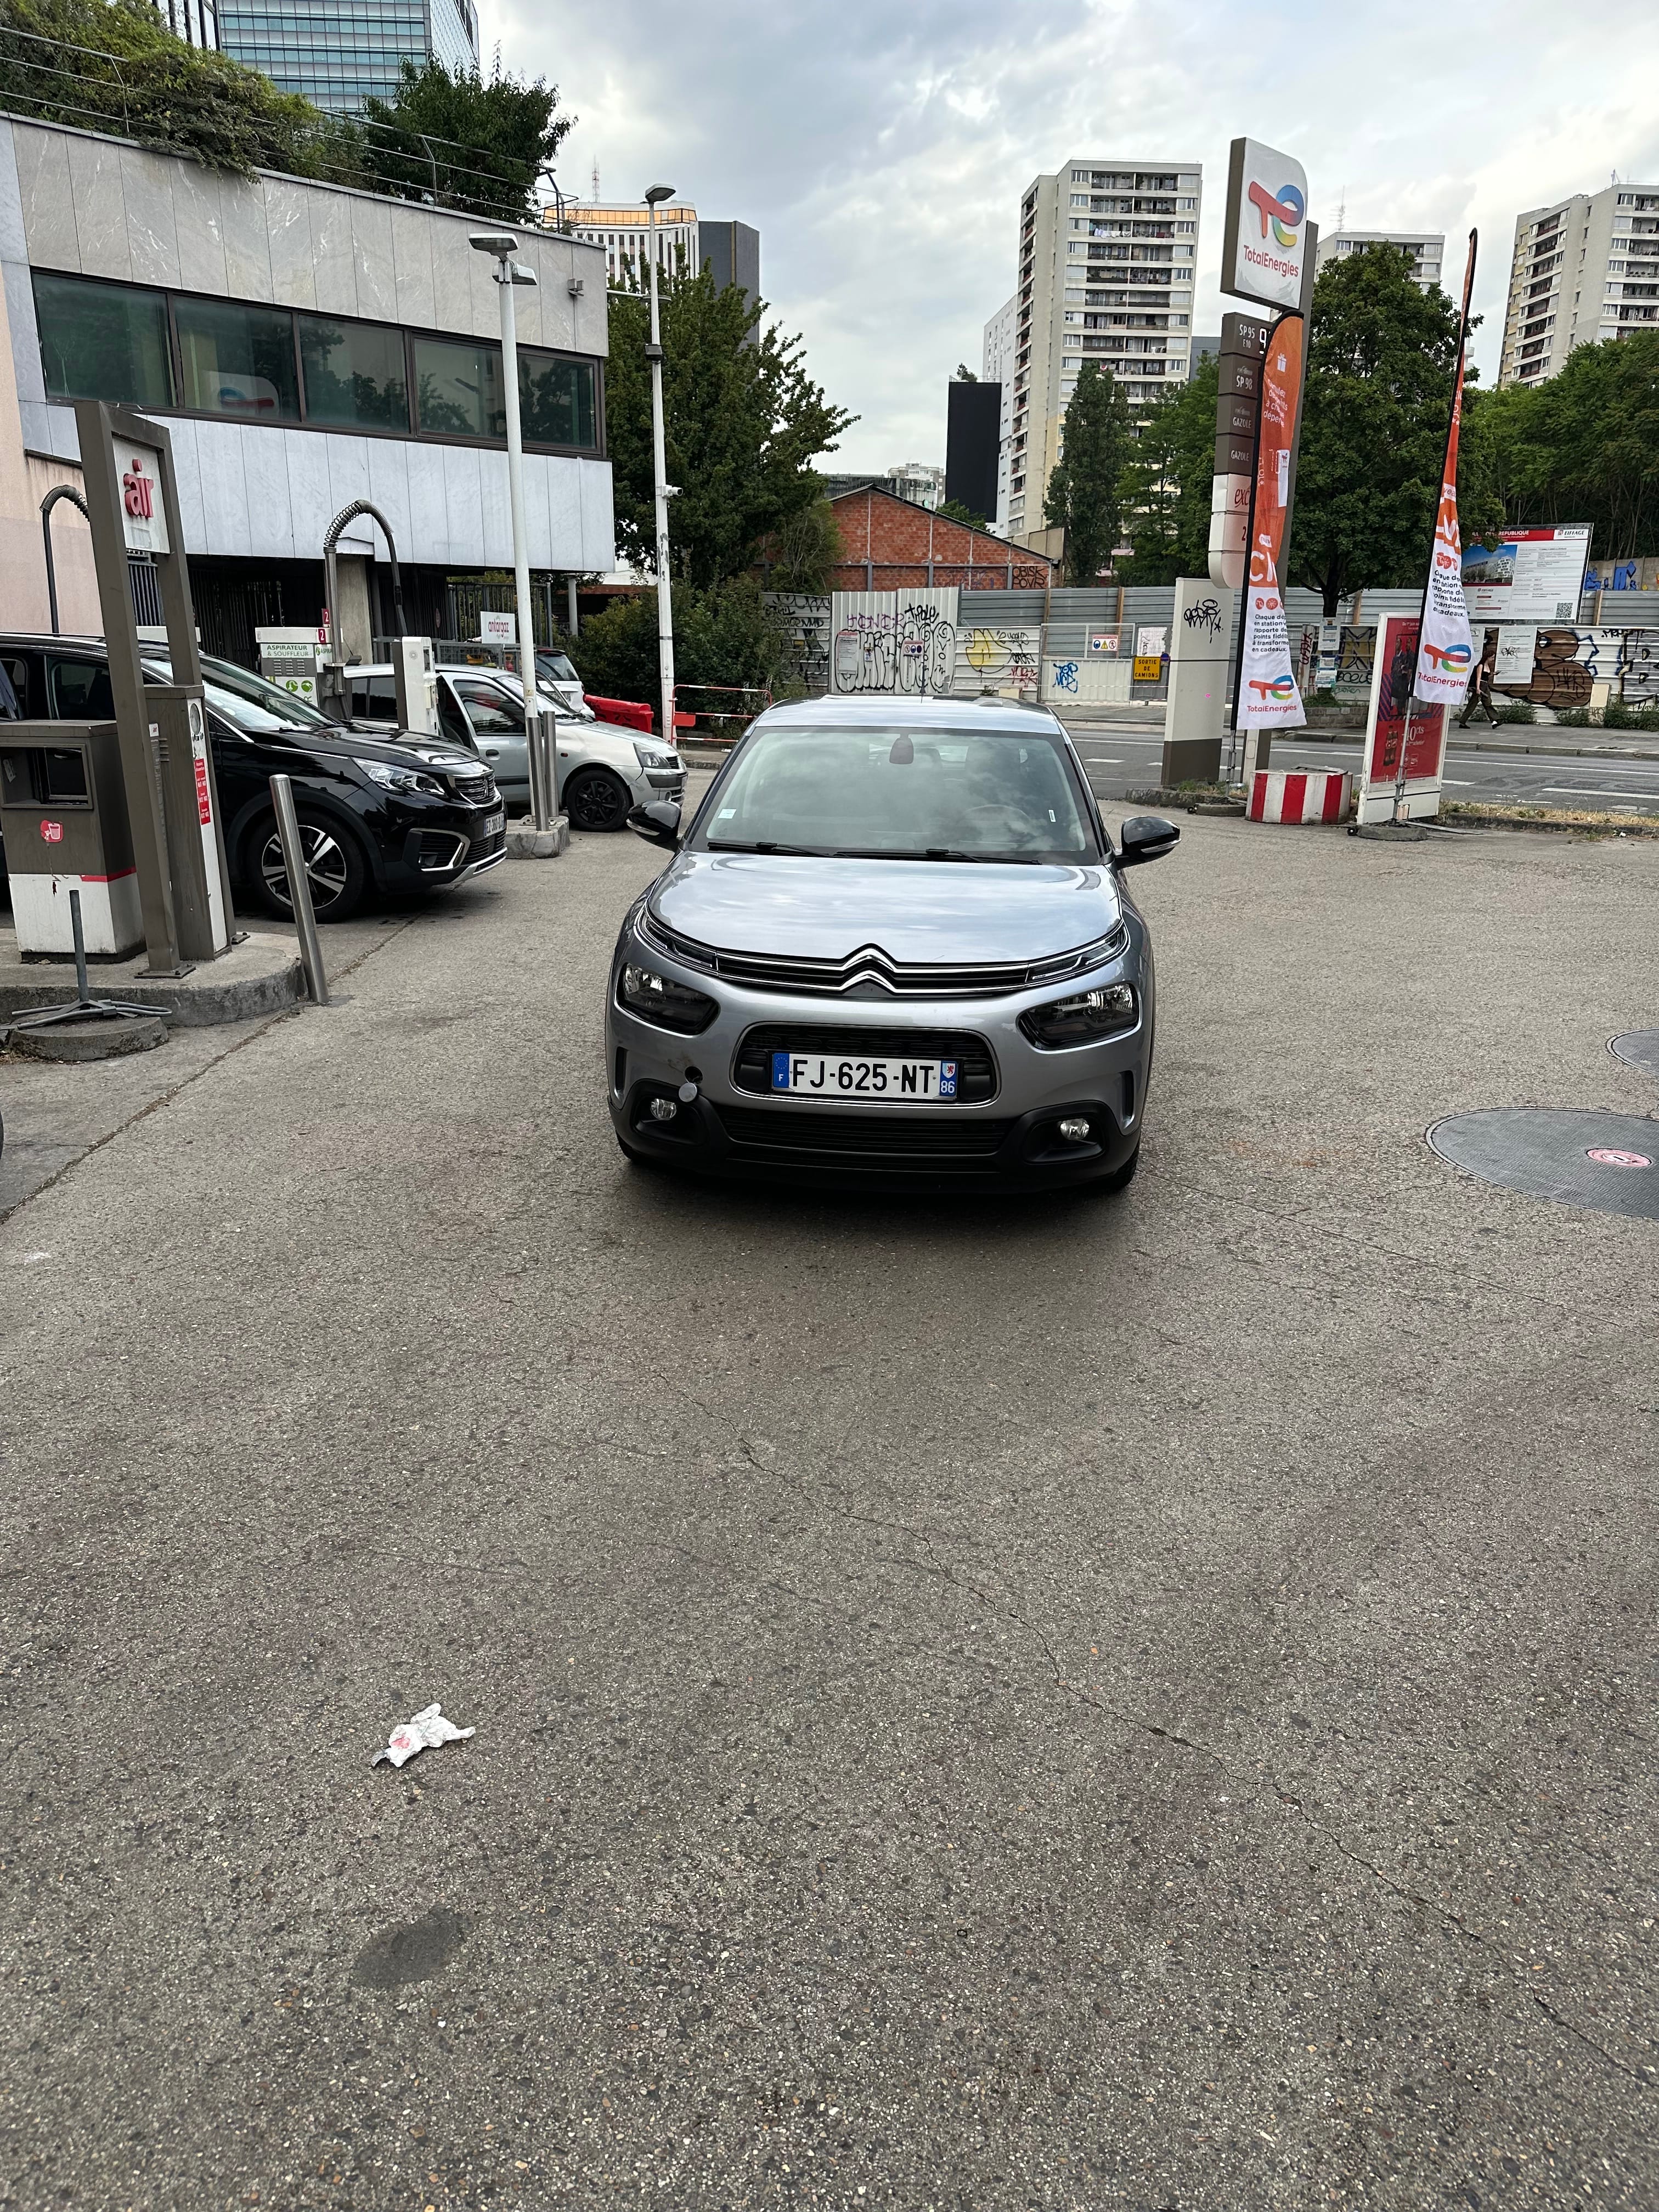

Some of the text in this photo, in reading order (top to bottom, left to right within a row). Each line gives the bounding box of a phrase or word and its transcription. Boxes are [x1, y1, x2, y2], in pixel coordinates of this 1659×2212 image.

[1243, 244, 1299, 278] TotalEnergies
[1239, 324, 1255, 339] SP 95
[1243, 338, 1251, 348] E10
[1236, 375, 1253, 390] SP 98
[1233, 417, 1251, 429] GAZOLE
[1231, 449, 1250, 461] GAZOLE
[123, 459, 154, 518] air
[325, 611, 329, 622] 2
[488, 618, 509, 637] antargaz
[320, 630, 325, 641] 2
[1247, 704, 1297, 713] TotalEnergies
[778, 1059, 956, 1094] F FJ-625-NT 86
